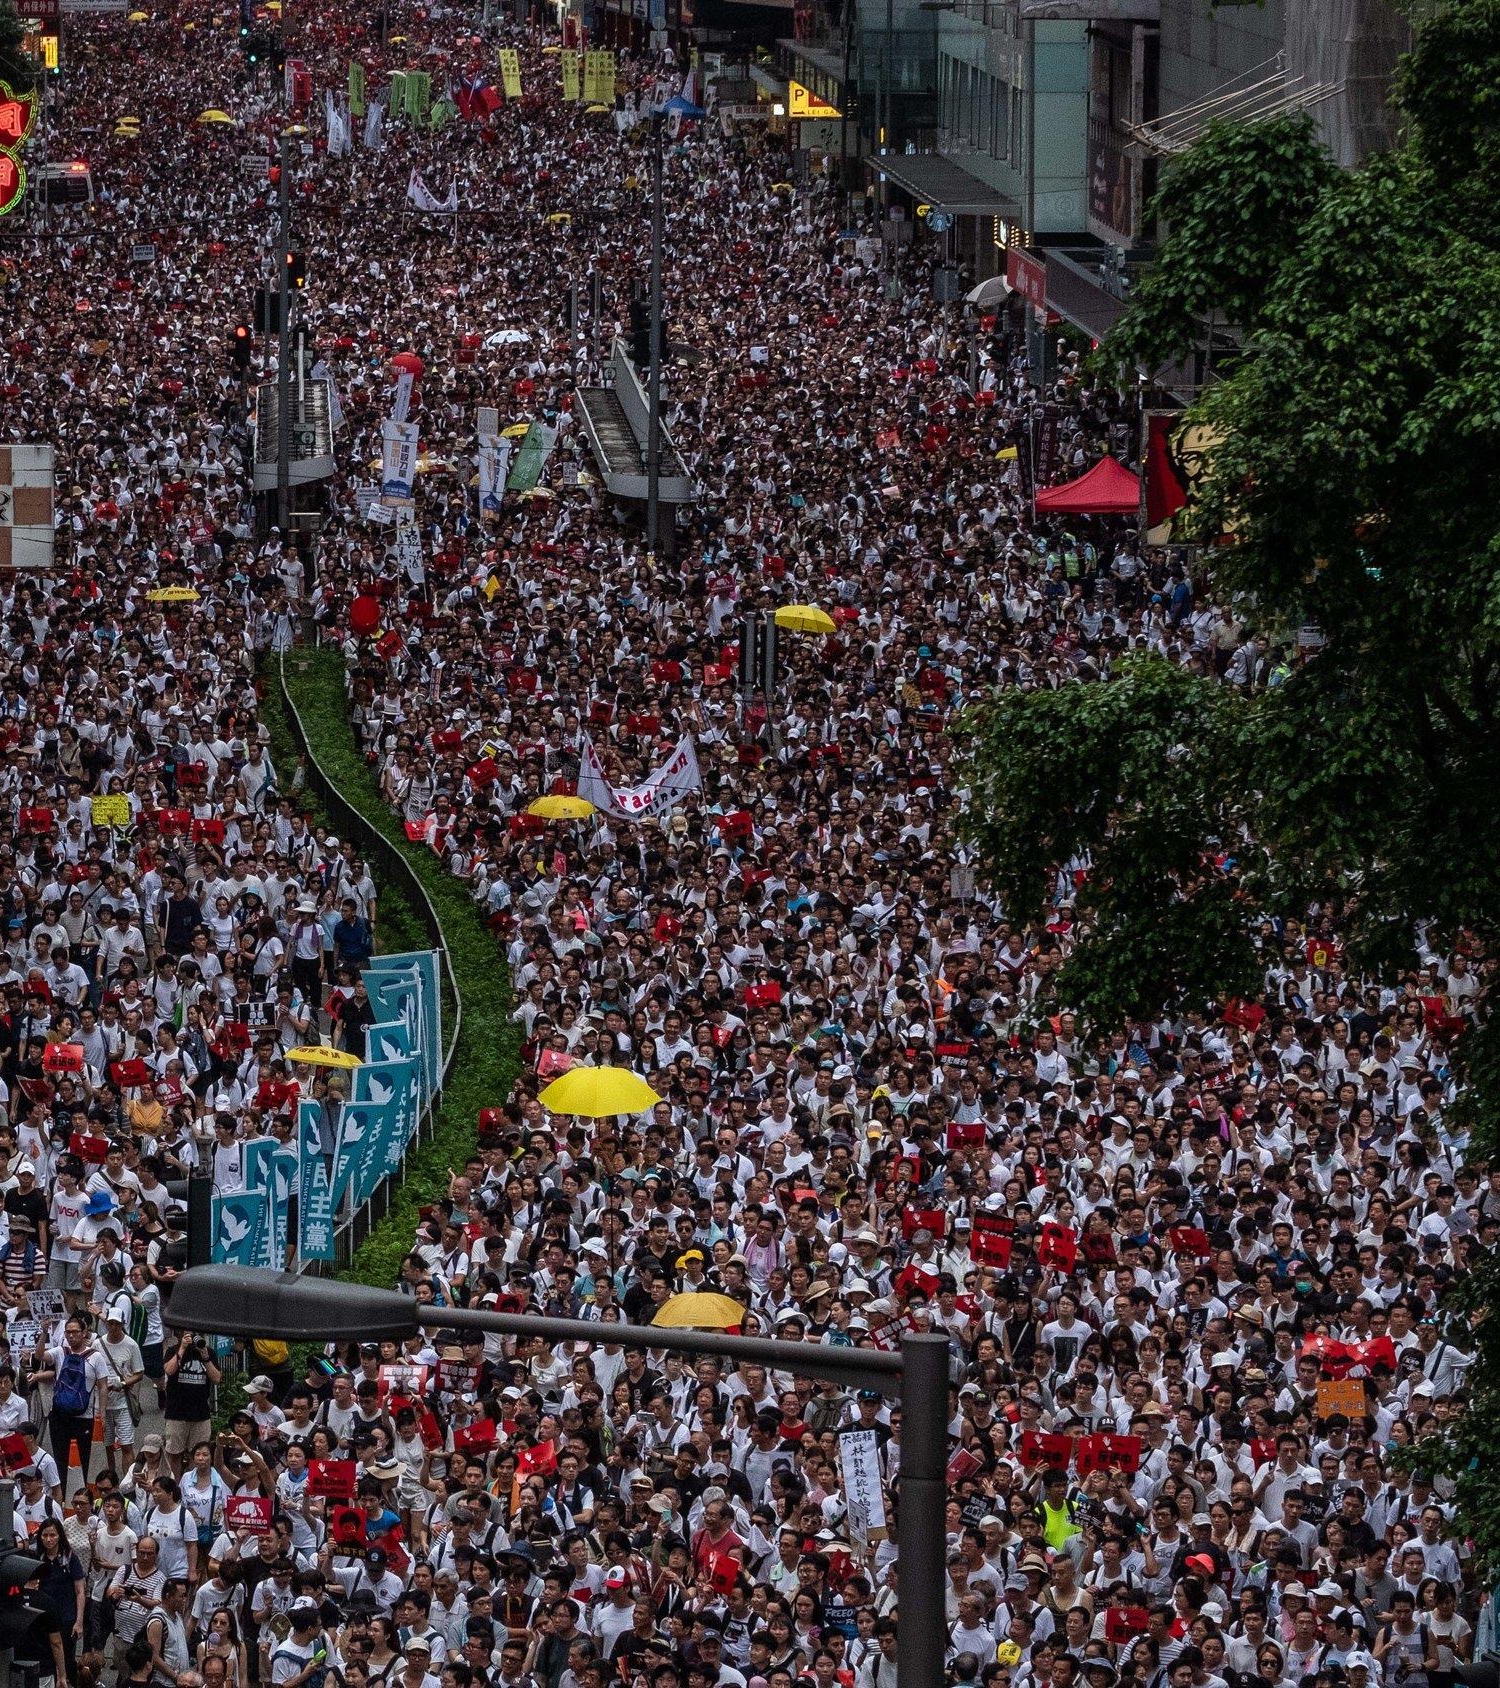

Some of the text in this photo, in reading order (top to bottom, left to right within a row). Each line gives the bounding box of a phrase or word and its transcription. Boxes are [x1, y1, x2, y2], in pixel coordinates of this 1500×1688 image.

[56, 1204, 80, 1218] NASA
[304, 1162, 331, 1252] 民主黨
